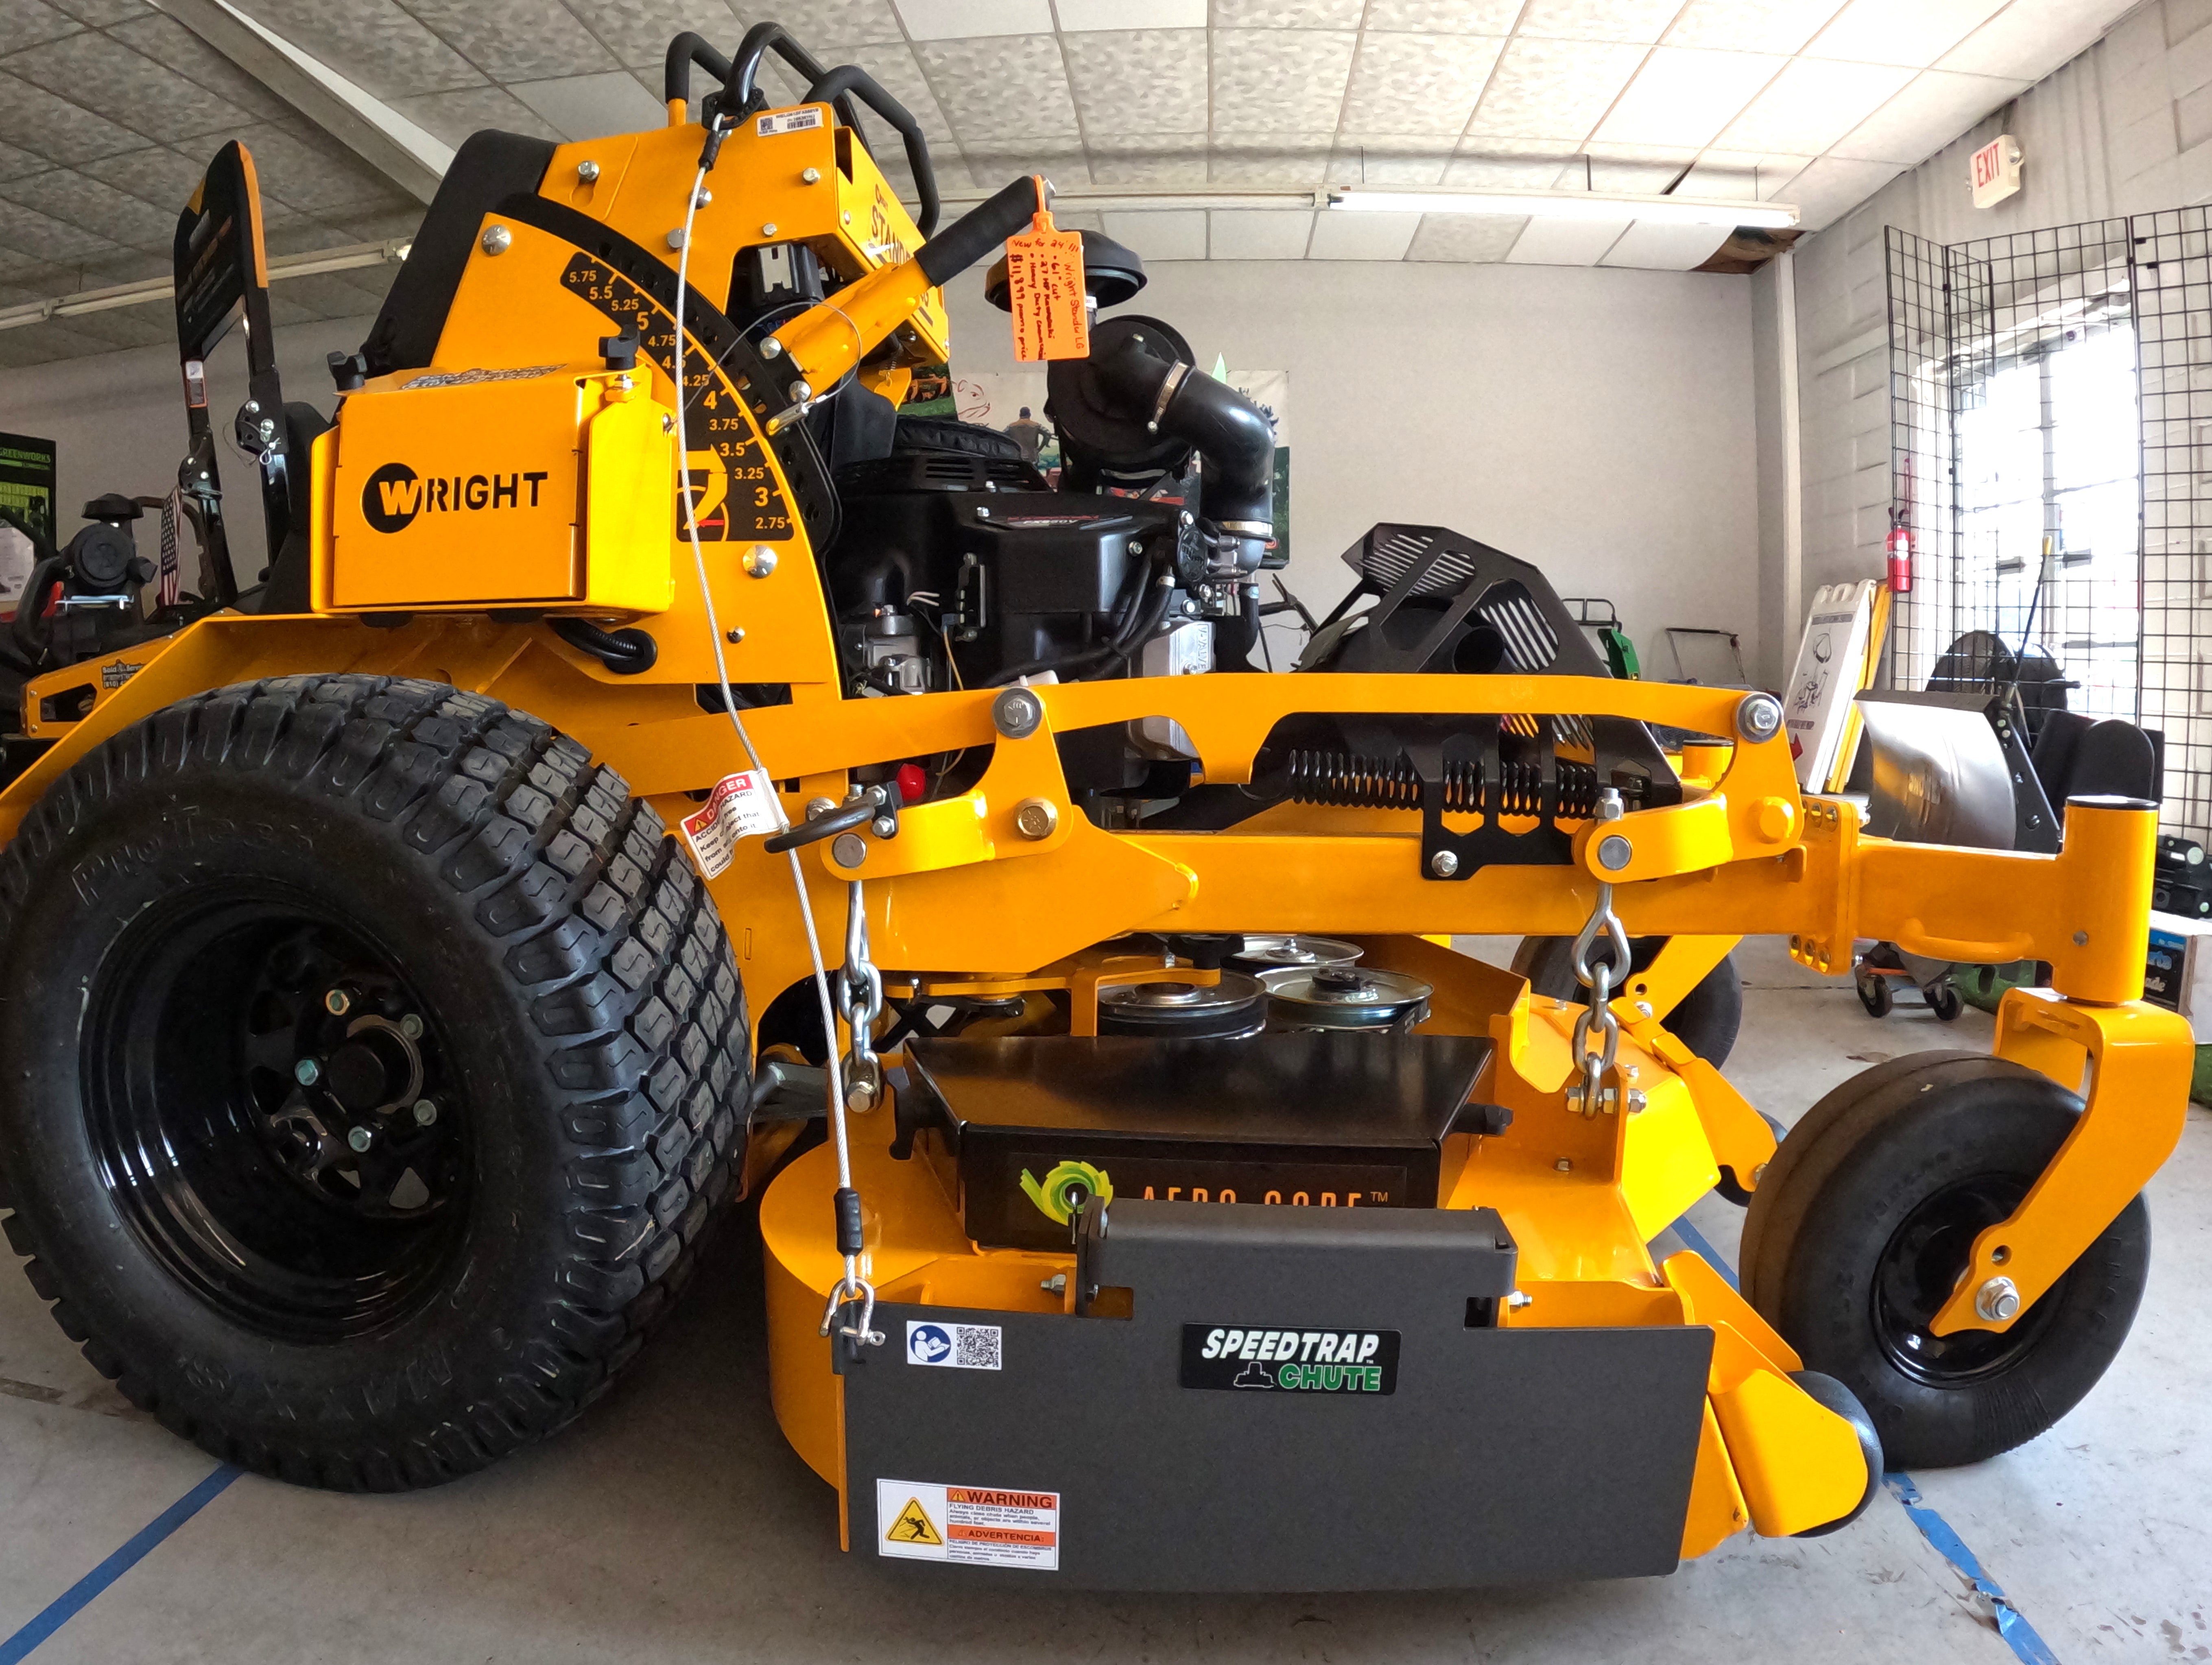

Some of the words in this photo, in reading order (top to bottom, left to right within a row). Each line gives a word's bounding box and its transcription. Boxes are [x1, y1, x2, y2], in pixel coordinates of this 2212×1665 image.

[1976, 142, 1999, 188] EXIT
[1041, 261, 1048, 274] 27
[569, 270, 596, 282] 5.75
[589, 286, 613, 300] 5.5
[611, 299, 639, 311] 5.25
[1064, 262, 1077, 297] Wright
[1075, 336, 1084, 349] LG
[636, 312, 649, 330] 5
[648, 334, 676, 347] 4.75
[682, 374, 710, 386] 4.25
[704, 391, 717, 409] 4
[709, 418, 739, 431] 3.75
[720, 442, 745, 457] 3.5
[734, 467, 764, 480] 3.25
[377, 470, 548, 517] WRIGHT
[755, 487, 769, 507] 3
[756, 517, 785, 530] 2.75
[707, 778, 746, 820] DANGER
[720, 791, 752, 811] HAZARD
[700, 837, 718, 852] Keep
[710, 853, 729, 872] could
[732, 825, 748, 838] onto
[705, 848, 723, 862] from
[1201, 1329, 1379, 1364] SPEEDTRAP
[1278, 1363, 1382, 1391] CHUTE
[967, 1491, 1052, 1508] WARNING
[968, 1530, 1041, 1542] ADVERTENCIA
